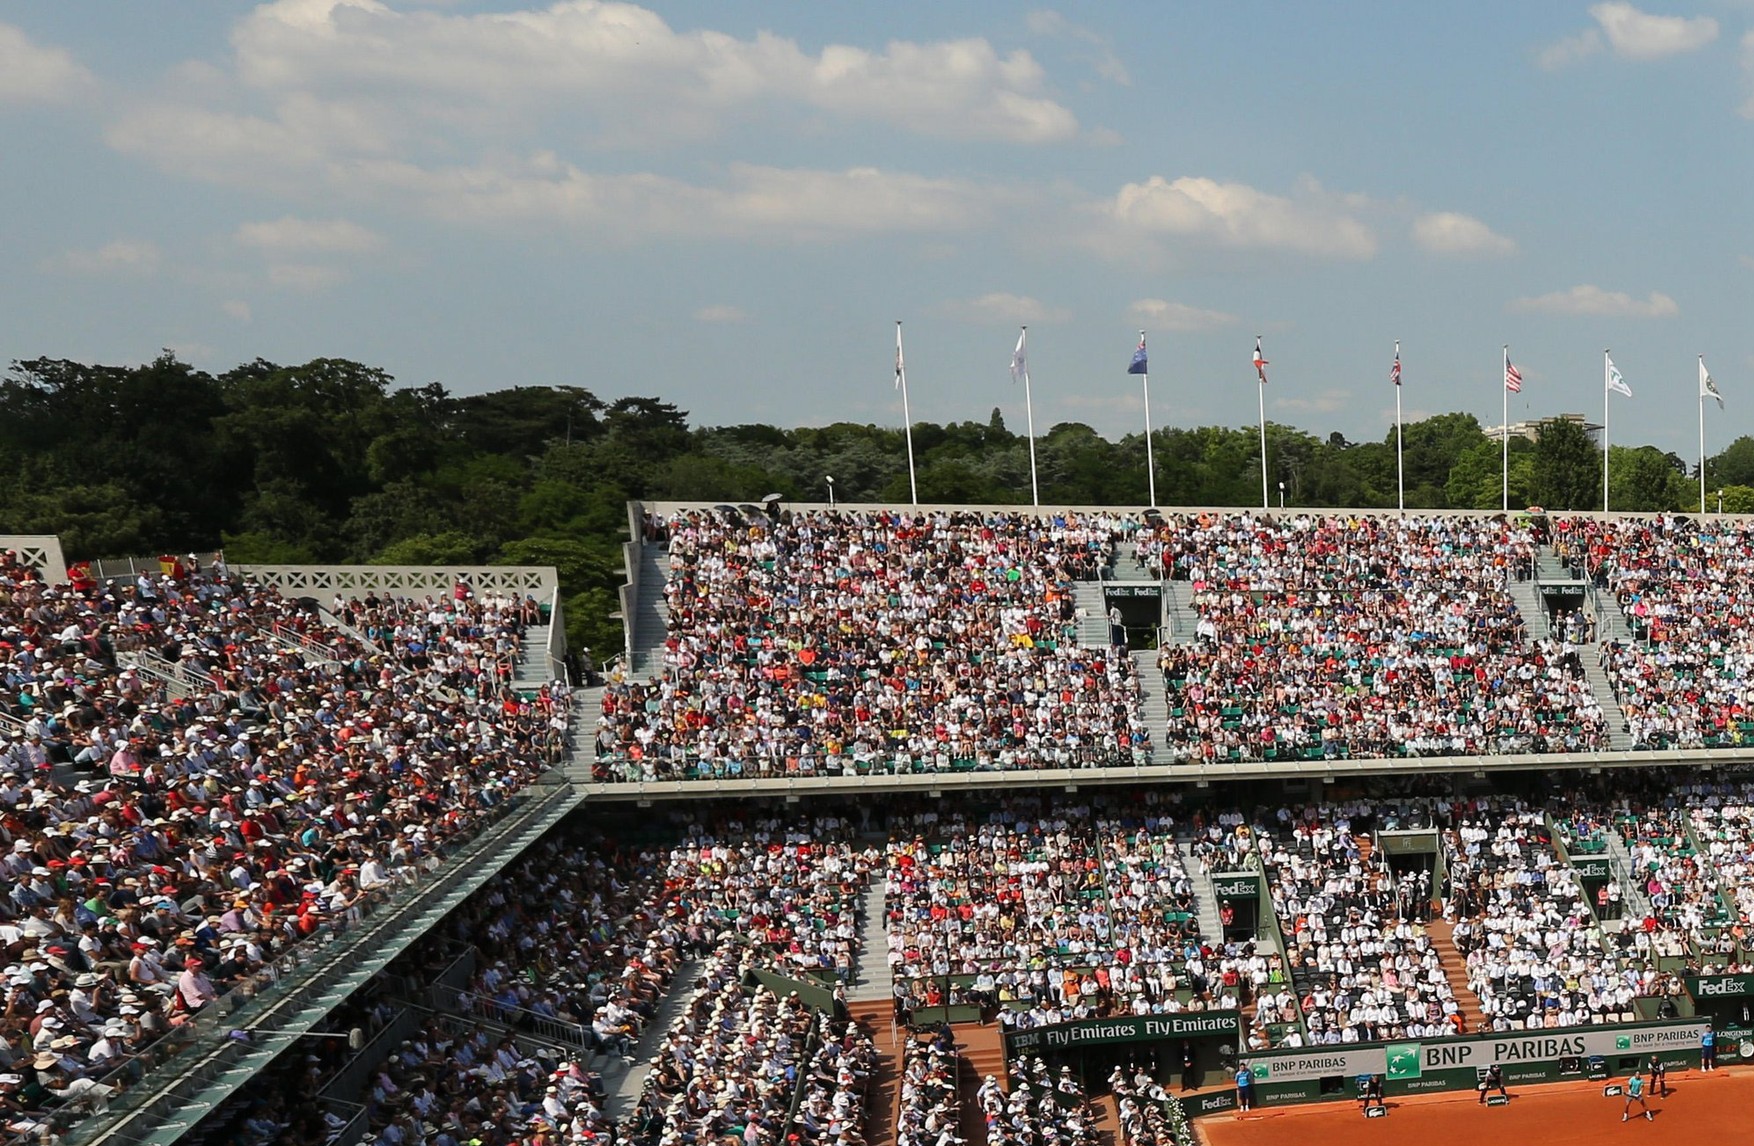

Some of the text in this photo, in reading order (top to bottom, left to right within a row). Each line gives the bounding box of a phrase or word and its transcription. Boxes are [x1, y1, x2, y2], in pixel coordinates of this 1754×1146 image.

[1214, 881, 1256, 896] FedEx
[1699, 978, 1745, 996] FedEx
[1015, 1016, 1237, 1048] IBM Fly Emirates Fly Emirates
[1633, 1029, 1700, 1044] BNP PARIBAS
[1427, 1036, 1586, 1067] BNP PARIBAS
[1272, 1057, 1347, 1072] BNP PARIBAS
[1522, 1071, 1546, 1079] PARIBAS
[1422, 1079, 1446, 1088] PARIBAS
[1281, 1091, 1306, 1100] PARIBAS
[1201, 1096, 1232, 1111] FedEx
